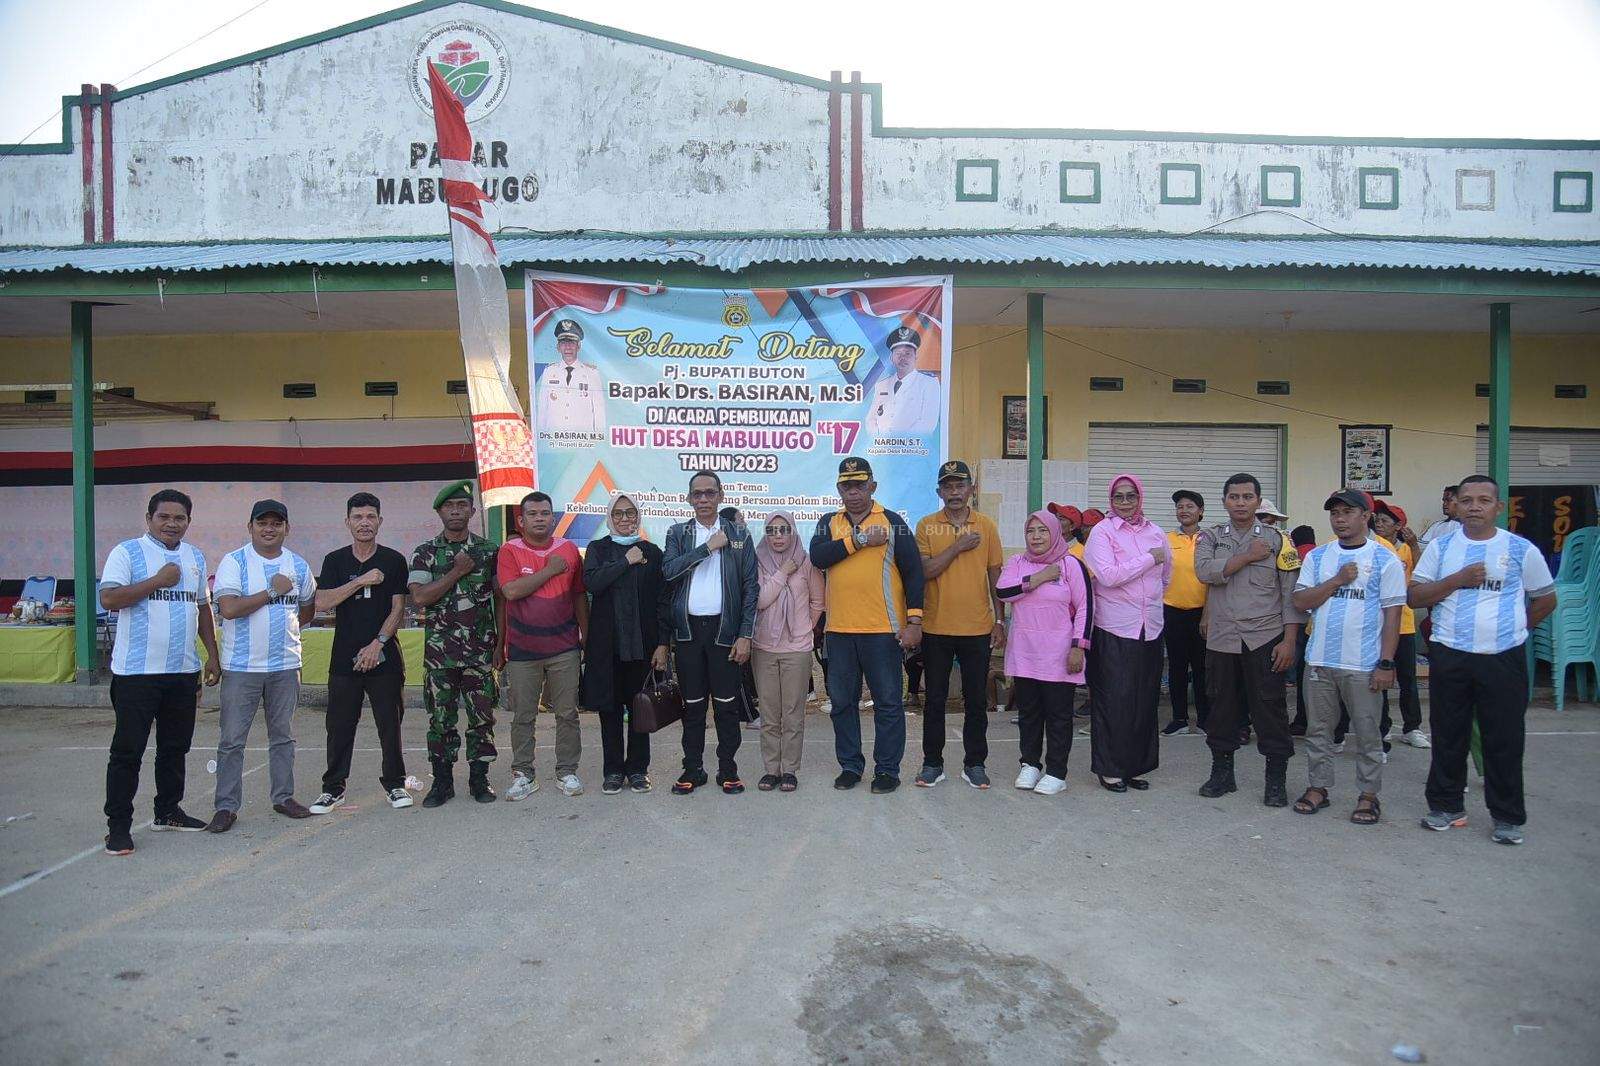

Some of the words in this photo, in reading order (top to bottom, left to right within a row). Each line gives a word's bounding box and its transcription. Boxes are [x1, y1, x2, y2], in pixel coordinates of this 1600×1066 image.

[410, 141, 509, 169] PAAR
[376, 175, 539, 205] MABUGO
[607, 326, 743, 359] Selamat
[758, 331, 865, 372] Datang
[689, 366, 745, 379] BUPATI
[750, 367, 805, 379] BUTON
[609, 383, 674, 402] Bapak
[676, 383, 713, 400] Drs.
[718, 384, 814, 403] BASIRAN,
[820, 385, 862, 402] M.Si
[647, 407, 666, 424] DI
[667, 407, 716, 425] ACARA
[718, 408, 811, 426] PEMBUKAAN
[611, 428, 648, 447] HUT
[653, 429, 700, 448] DESA
[705, 430, 814, 450] MABULUGO
[817, 422, 833, 435] KE
[832, 422, 860, 454] 17
[679, 453, 733, 471] TAHUN
[734, 454, 778, 472] 2023
[737, 483, 763, 492] Tema
[658, 493, 677, 503] Dan
[743, 496, 786, 505] Bersama
[788, 496, 819, 506] Dalam
[822, 497, 844, 507] Bing
[639, 507, 695, 517] erlandaska
